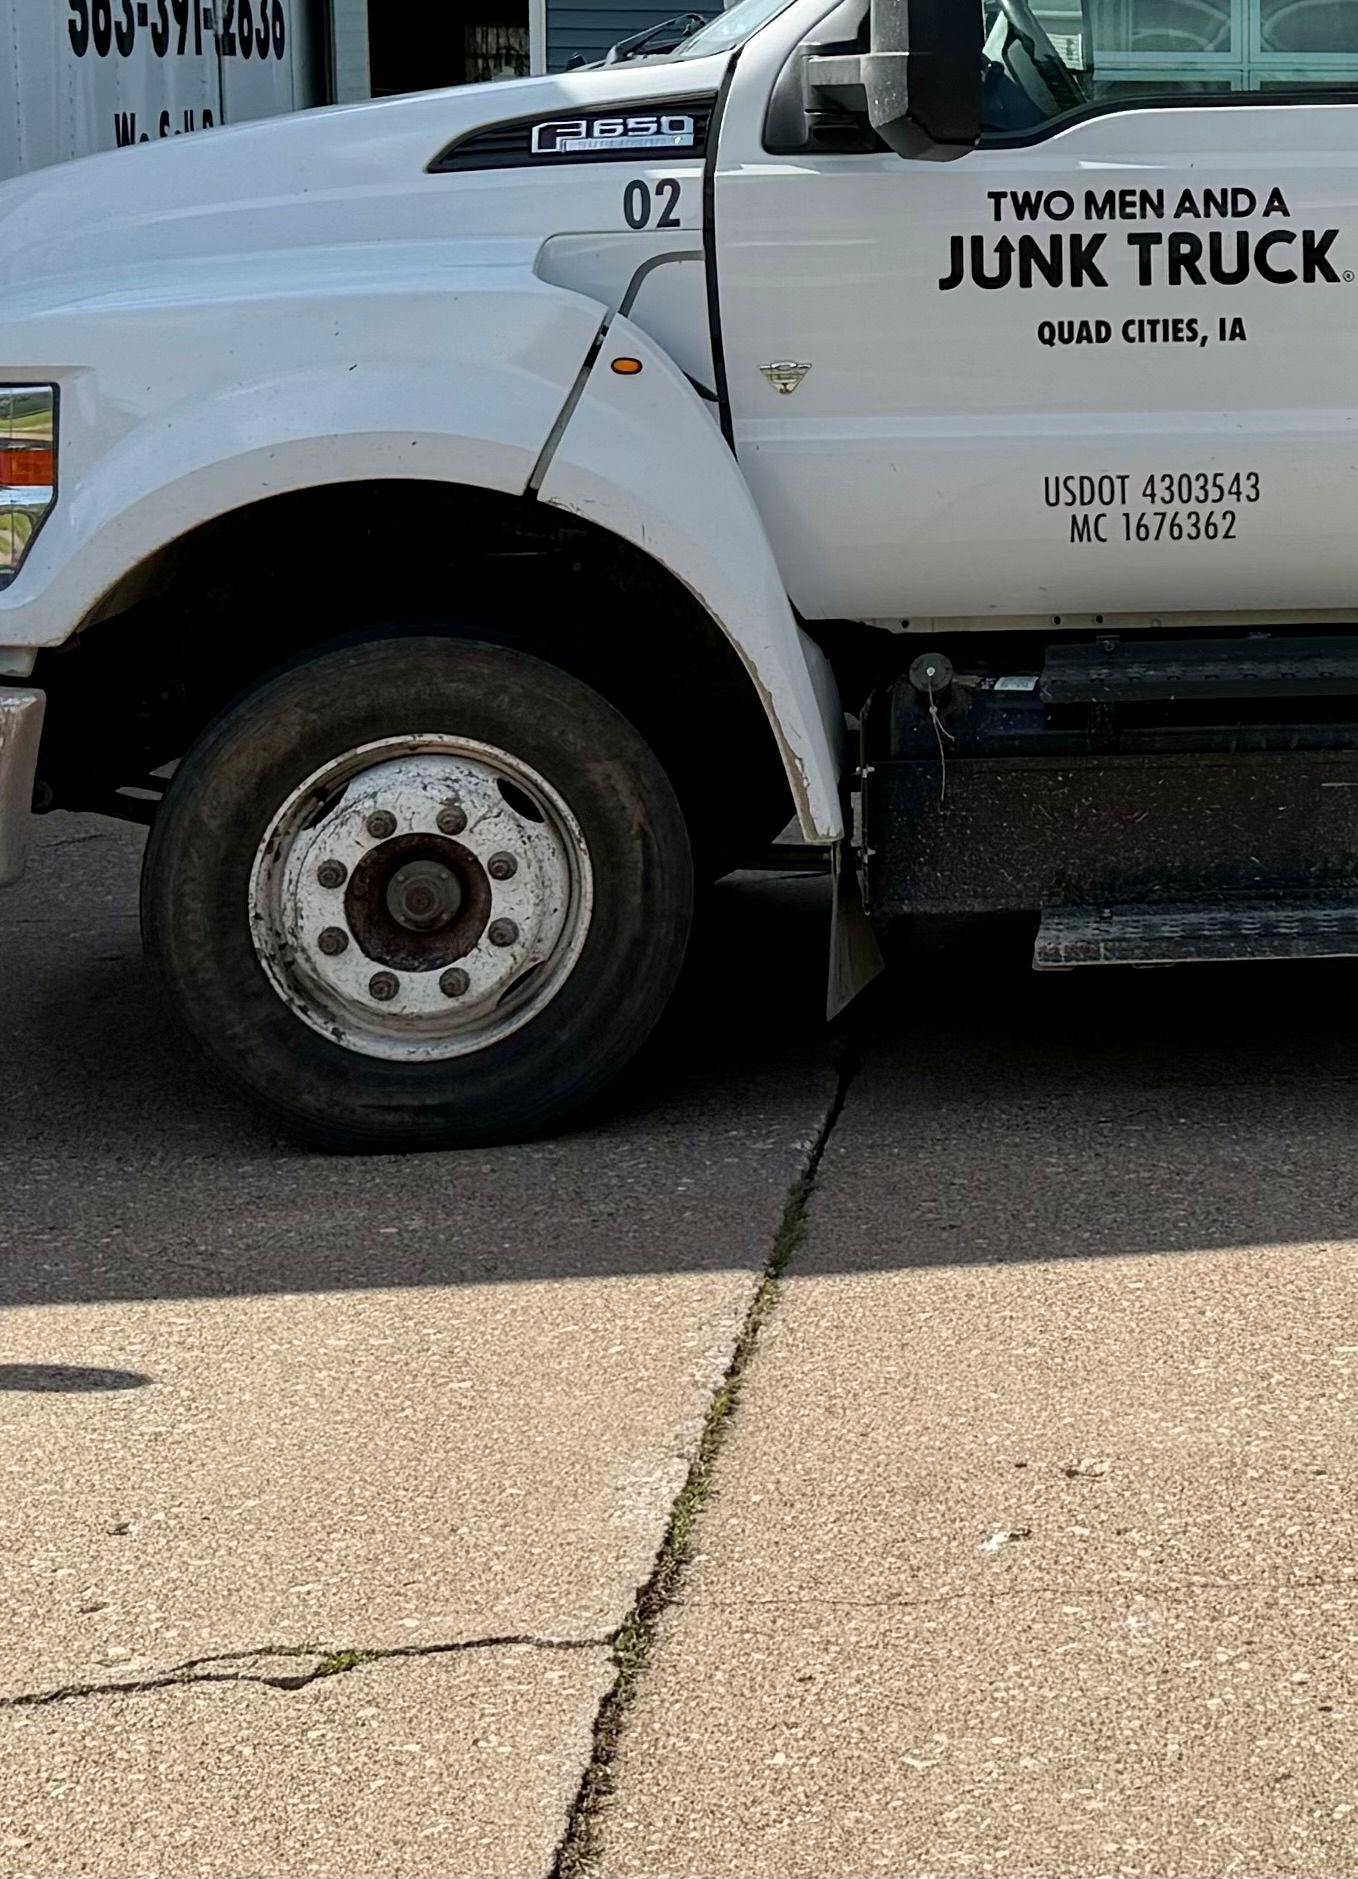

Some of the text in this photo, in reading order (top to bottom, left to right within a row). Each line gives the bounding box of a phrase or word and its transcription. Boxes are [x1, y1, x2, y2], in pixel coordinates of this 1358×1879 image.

[623, 177, 682, 230] 02
[987, 186, 1291, 222] TWO MEN AND A
[938, 232, 1109, 291] JUNK
[1037, 316, 1247, 348] QUAD CITIES, IA
[1044, 471, 1261, 508] USDOT 4303543
[1070, 510, 1237, 544] MC 1676362
